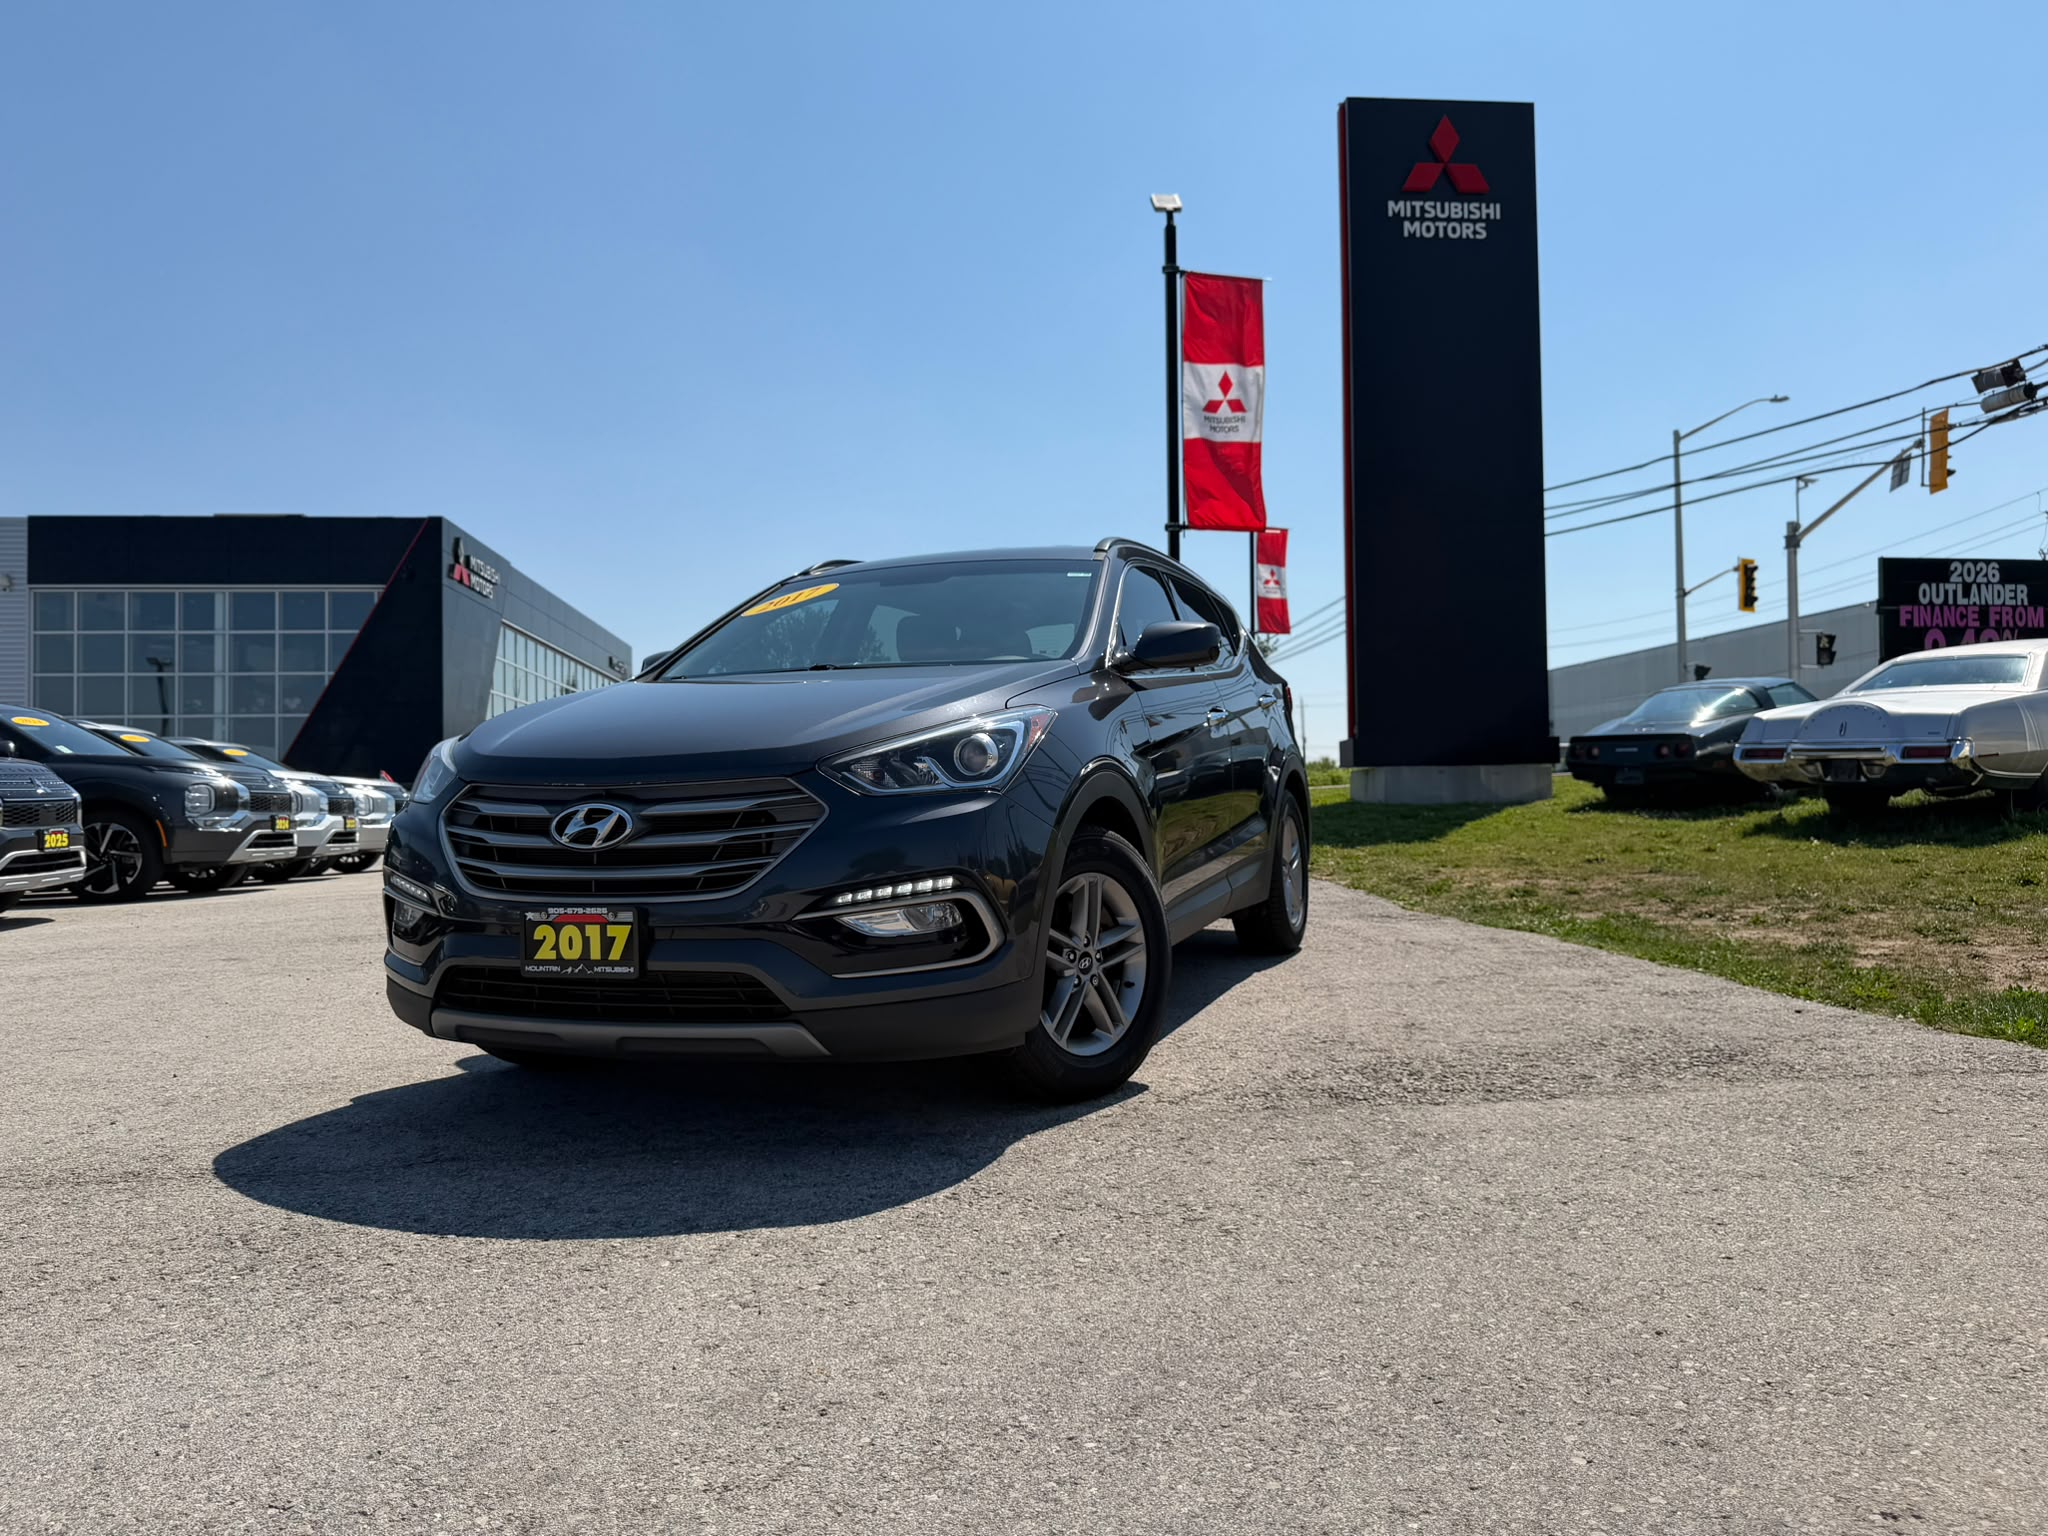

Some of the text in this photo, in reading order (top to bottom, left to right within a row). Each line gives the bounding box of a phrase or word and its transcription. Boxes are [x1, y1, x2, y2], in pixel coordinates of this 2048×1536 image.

[1387, 200, 1501, 220] MITSUBISHI
[1403, 221, 1488, 239] MOTORS
[1203, 415, 1246, 425] MITSUBISHI
[1209, 425, 1239, 433] MOTORS
[1949, 560, 2000, 583] 2026
[1918, 582, 2029, 606] OUTLANDER
[1900, 605, 2045, 628] FINANCE FROM
[44, 833, 69, 848] 2025
[533, 924, 632, 960] 2017
